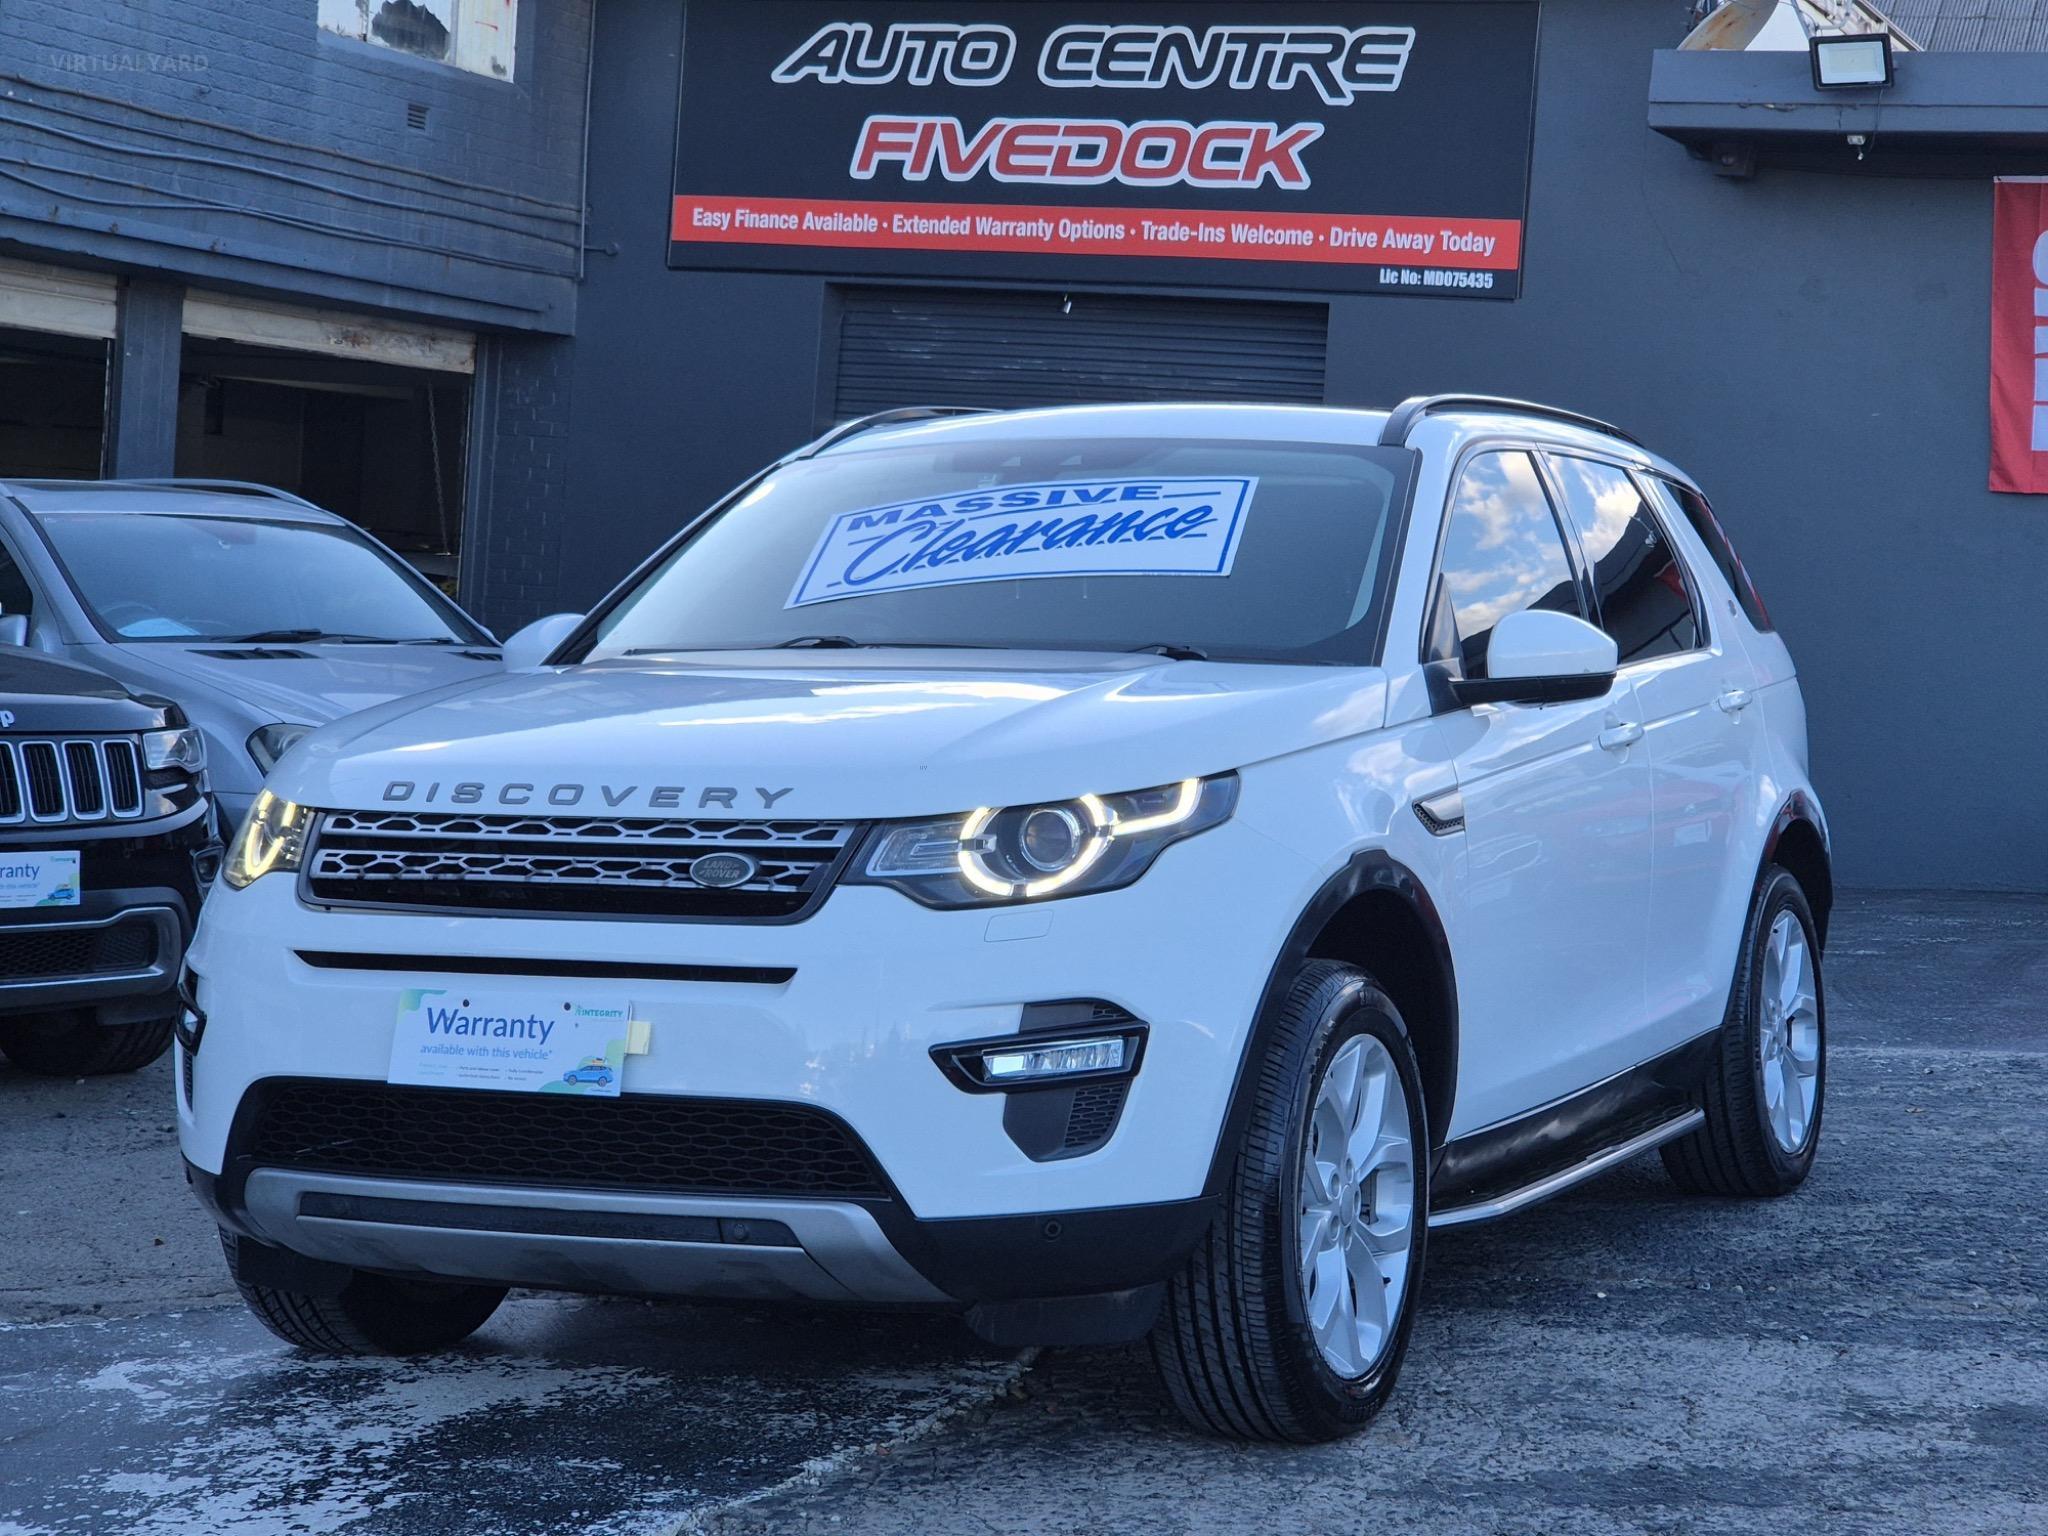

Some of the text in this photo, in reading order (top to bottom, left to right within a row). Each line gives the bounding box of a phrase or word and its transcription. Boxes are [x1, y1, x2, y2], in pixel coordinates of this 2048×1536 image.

[771, 22, 1415, 106] AUTO CENTRE
[849, 115, 1324, 190] FIVEDOCK
[692, 208, 1495, 256] Easy Finance Available Extended Warranty Options Trade-Ins Welcome Drive Away Today
[1380, 267, 1494, 289] Lic No: MD075435
[846, 485, 1163, 533] MASSIVE
[842, 504, 1213, 586] Clearance
[382, 780, 794, 810] DISCOVERY
[427, 1006, 554, 1045] Warranty
[582, 1009, 624, 1018] INTEGRITY
[420, 1042, 464, 1056] available
[467, 1046, 489, 1058] with
[492, 1047, 511, 1059] this
